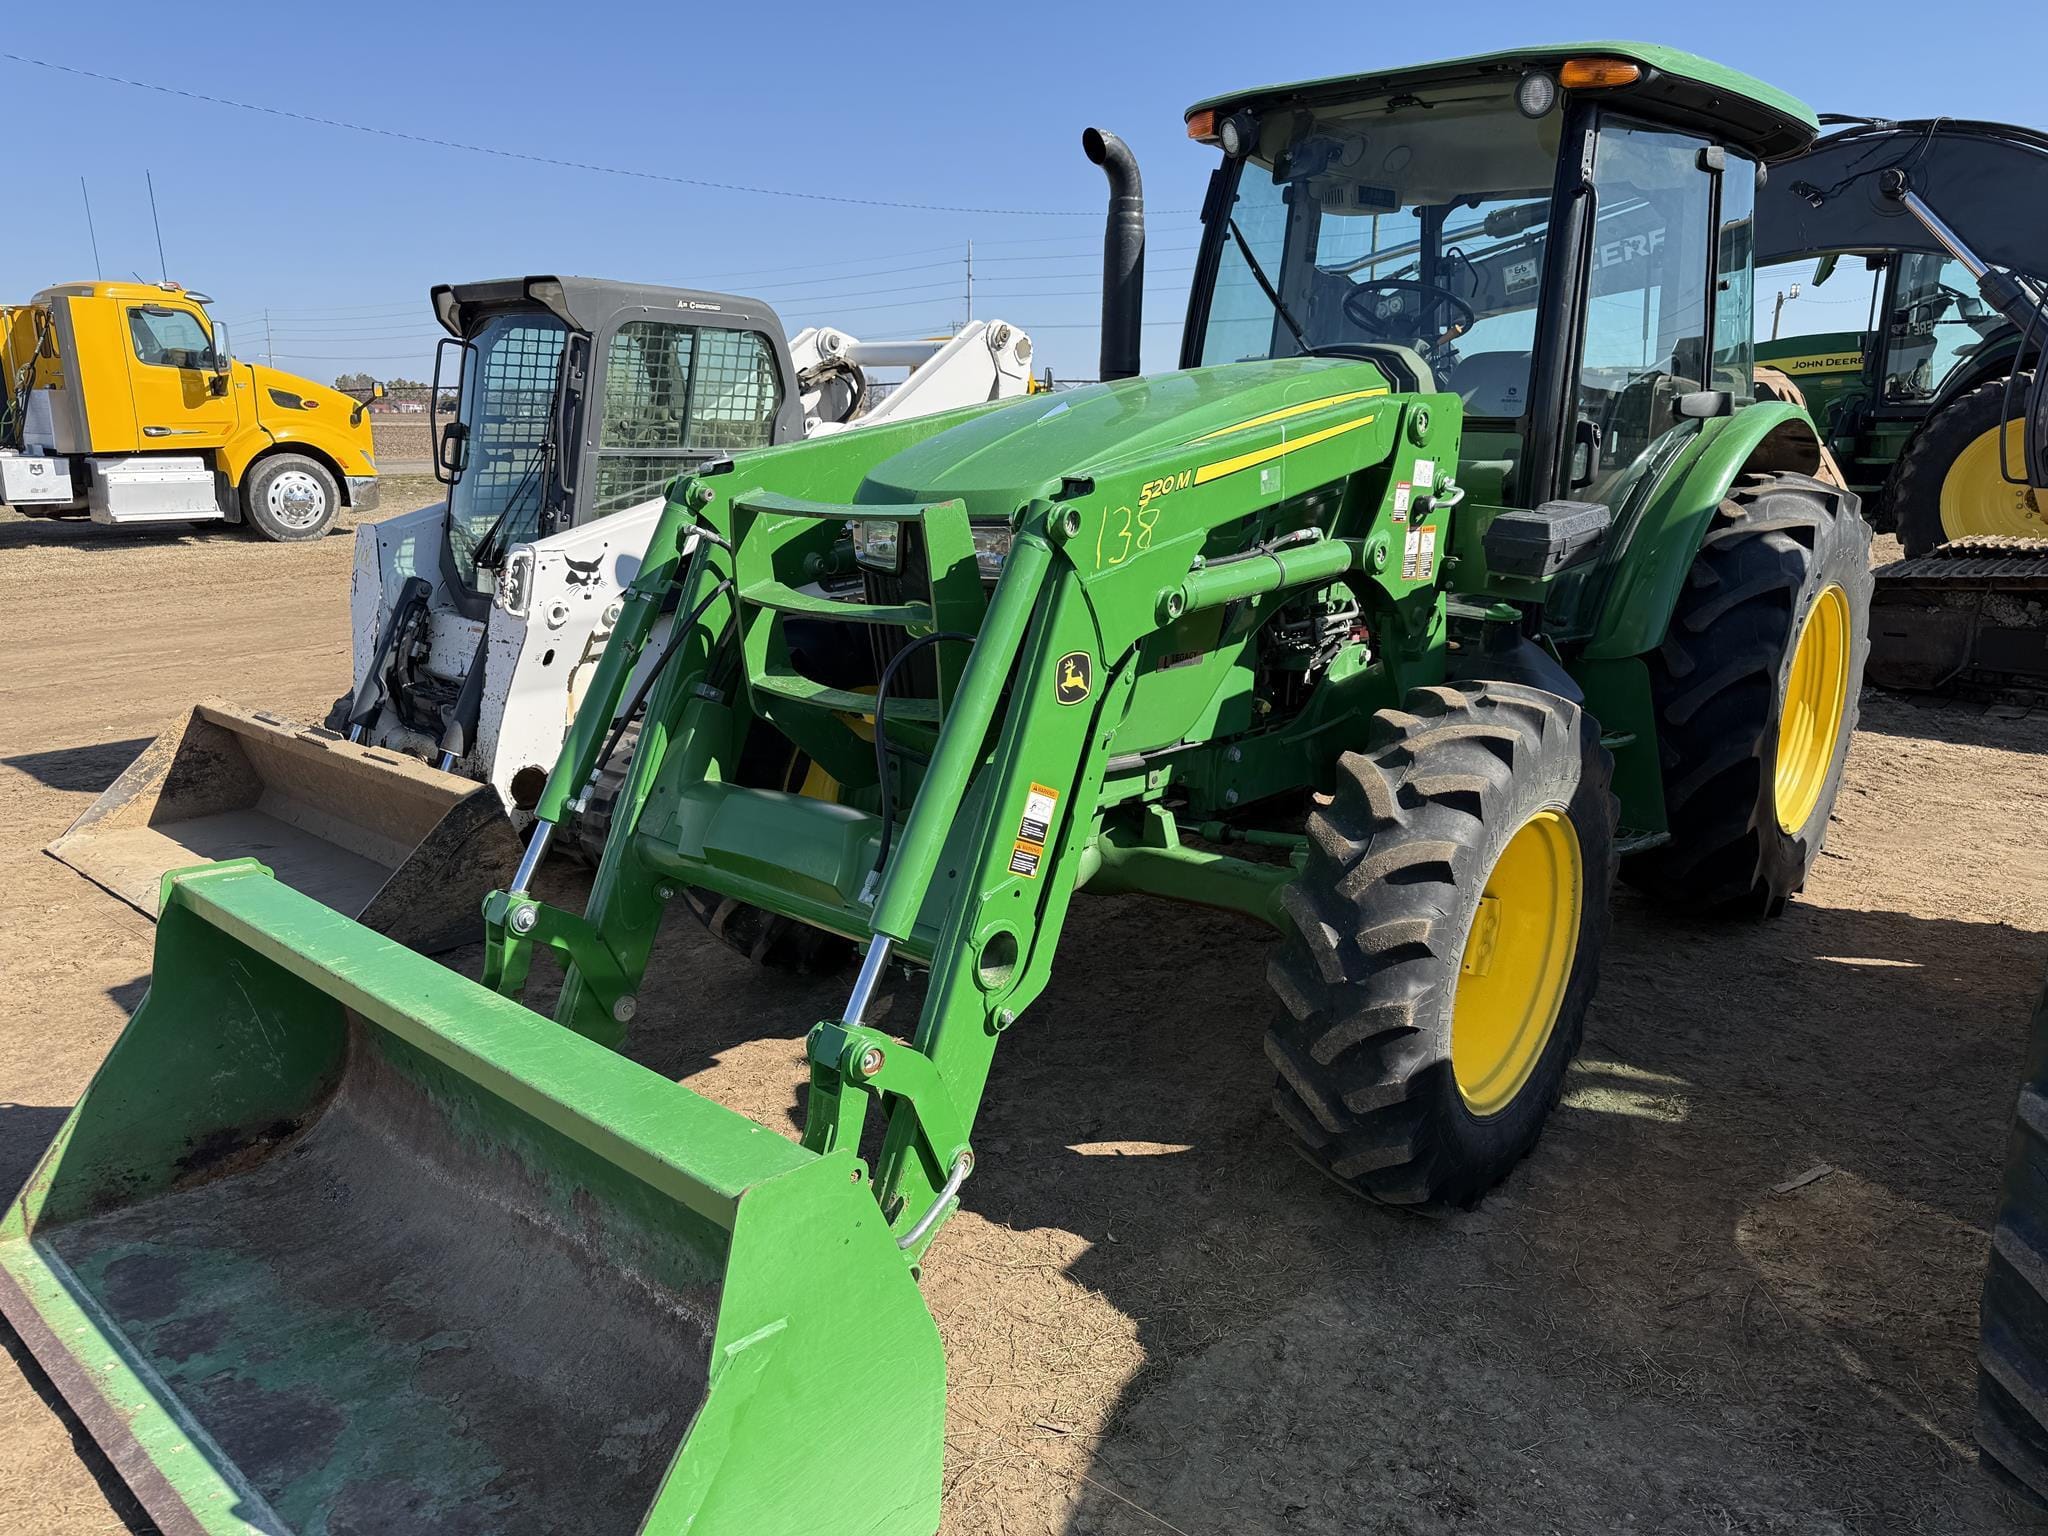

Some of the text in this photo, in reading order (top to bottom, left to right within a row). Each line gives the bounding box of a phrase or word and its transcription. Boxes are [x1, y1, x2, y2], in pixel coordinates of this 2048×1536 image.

[1792, 357, 1865, 369] JOHN DEERE
[1138, 468, 1192, 507] 520 M
[1096, 505, 1160, 570] 138
